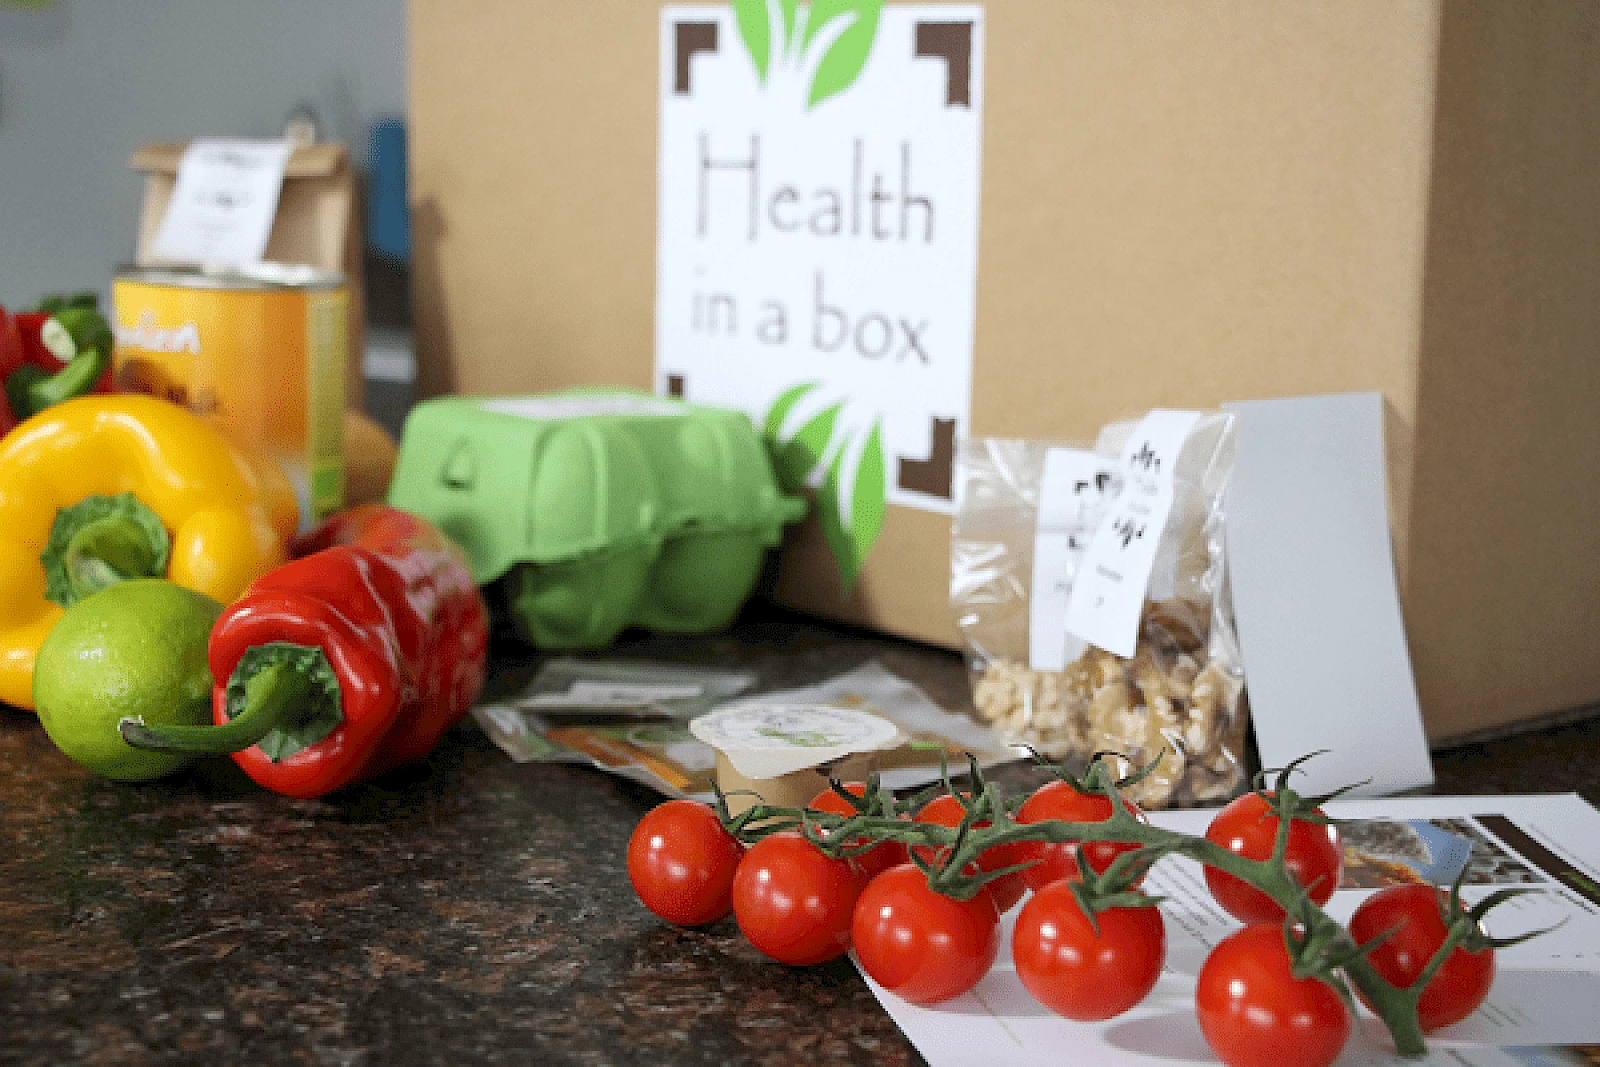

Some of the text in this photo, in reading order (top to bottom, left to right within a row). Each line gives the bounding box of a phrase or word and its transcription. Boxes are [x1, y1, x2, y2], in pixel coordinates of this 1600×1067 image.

[696, 131, 935, 242] Health
[692, 265, 930, 363] in a box
